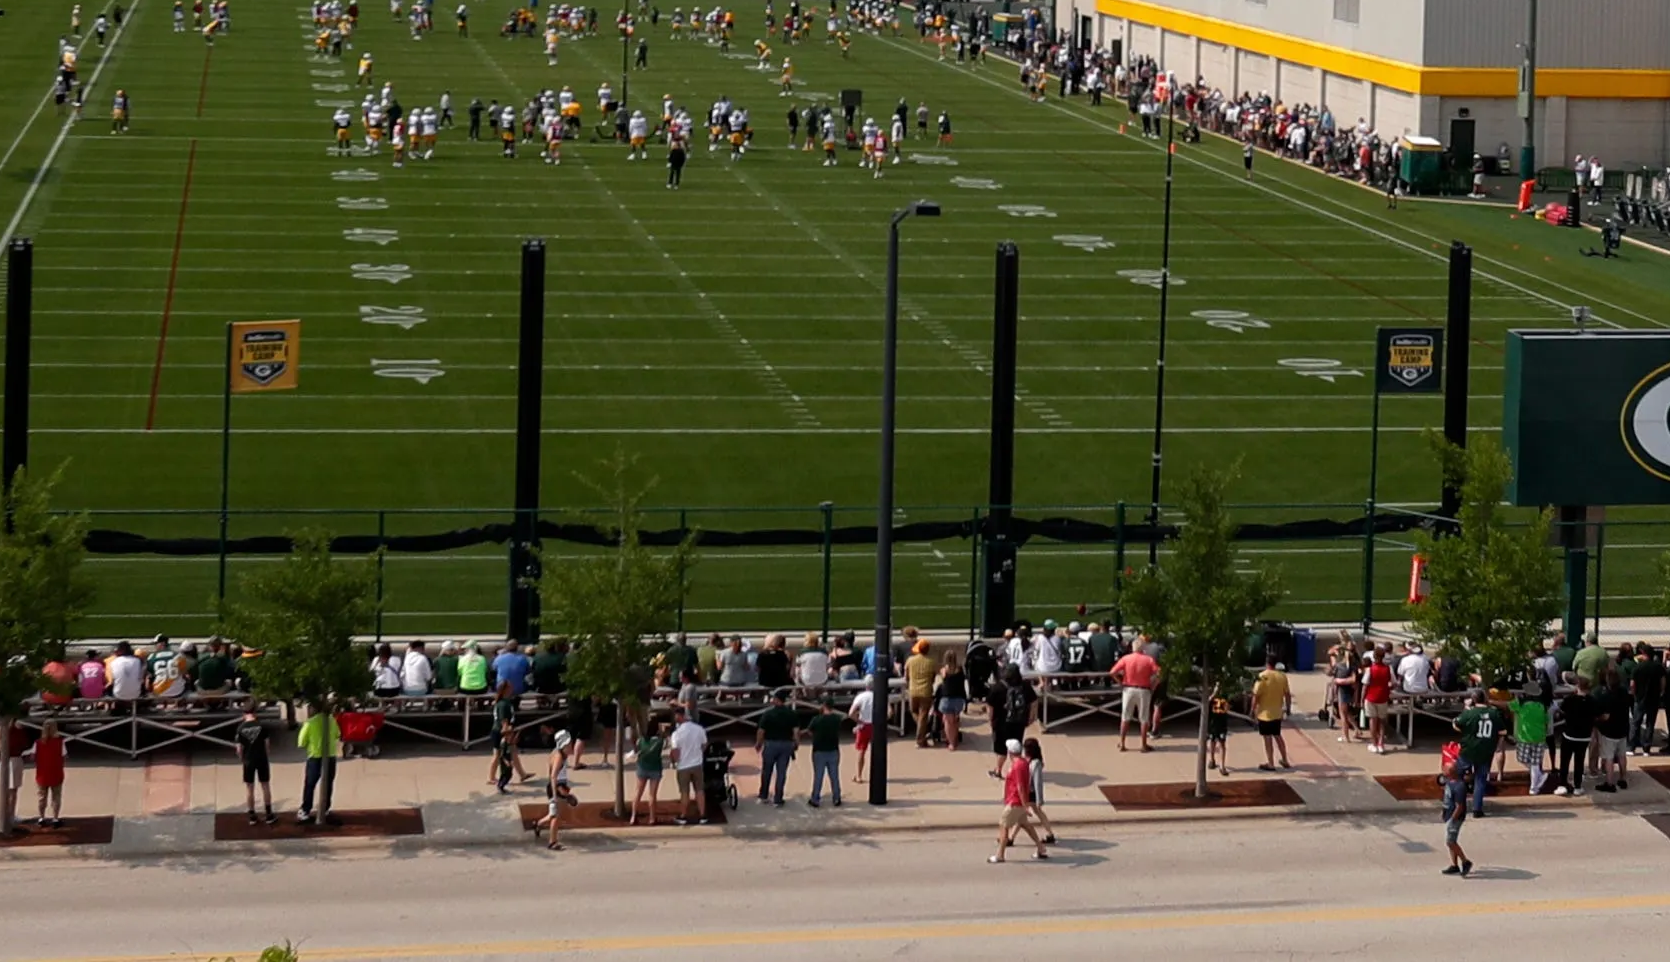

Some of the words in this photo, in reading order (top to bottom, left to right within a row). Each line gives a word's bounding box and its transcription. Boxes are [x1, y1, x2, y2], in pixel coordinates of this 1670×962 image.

[359, 305, 427, 324] 20
[1190, 309, 1272, 329] 20
[1393, 348, 1429, 356] TRAINING
[1400, 356, 1422, 364] CAMP
[370, 358, 446, 378] 10
[1277, 357, 1365, 377] 10
[1068, 646, 1085, 664] 17
[1476, 720, 1492, 738] 10
